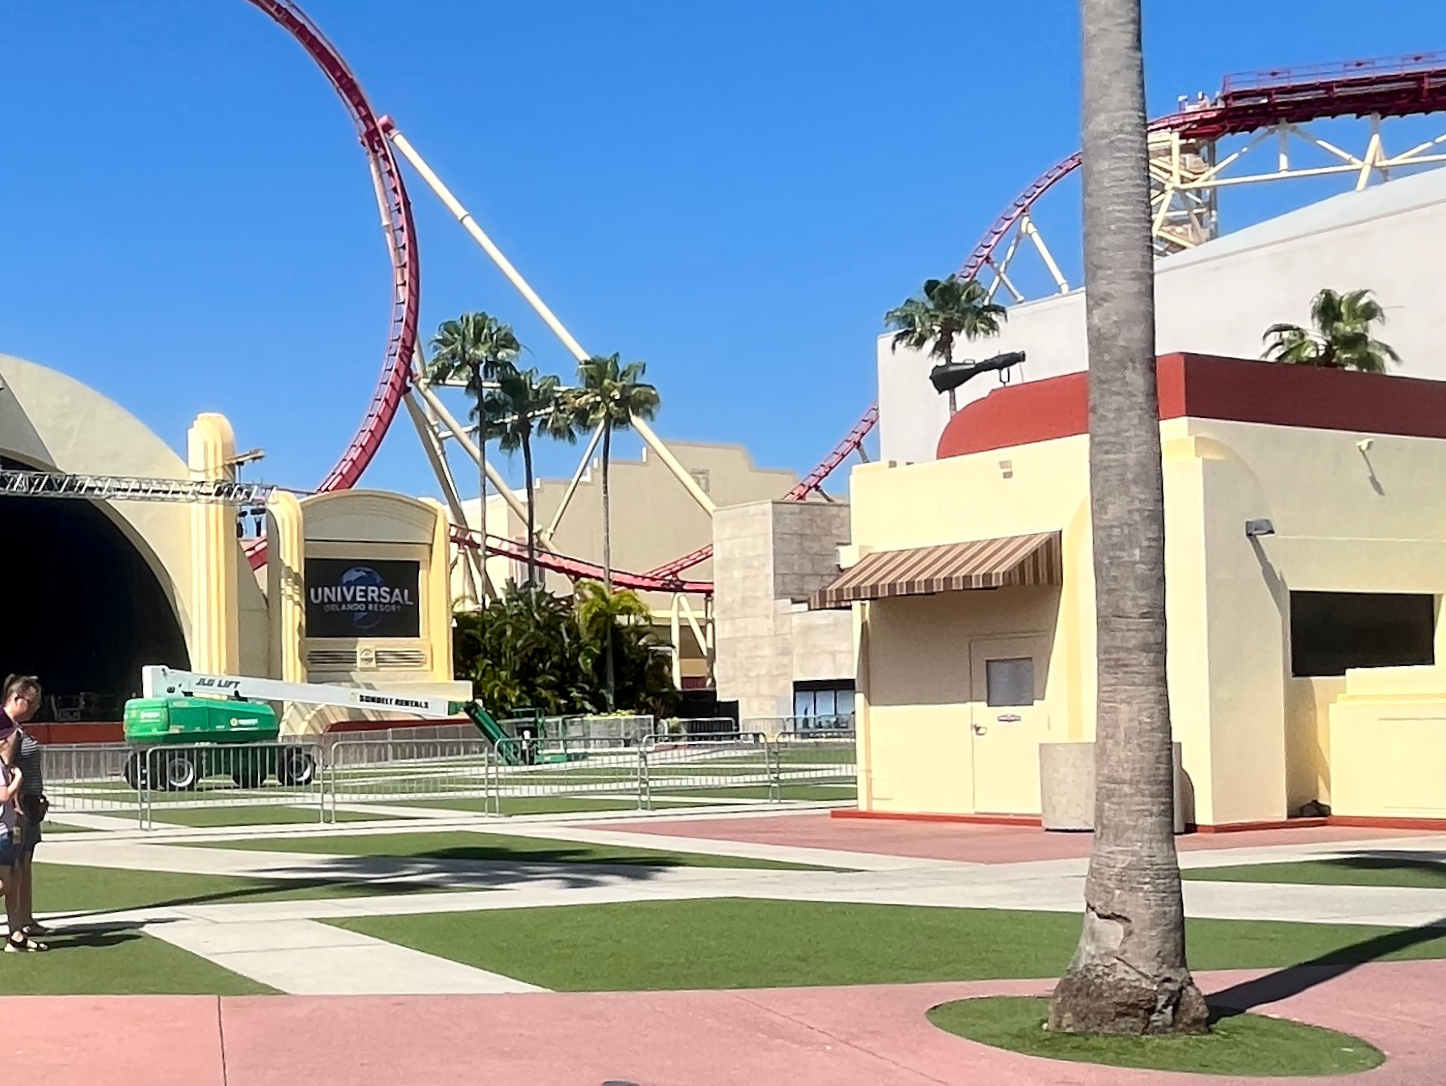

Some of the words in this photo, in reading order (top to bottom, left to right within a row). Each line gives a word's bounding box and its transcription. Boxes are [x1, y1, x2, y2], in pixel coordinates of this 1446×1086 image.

[310, 586, 414, 605] UNIVERSAL
[323, 603, 366, 612] ORLANDO
[368, 603, 402, 612] RESORT
[217, 679, 241, 689] LIFT
